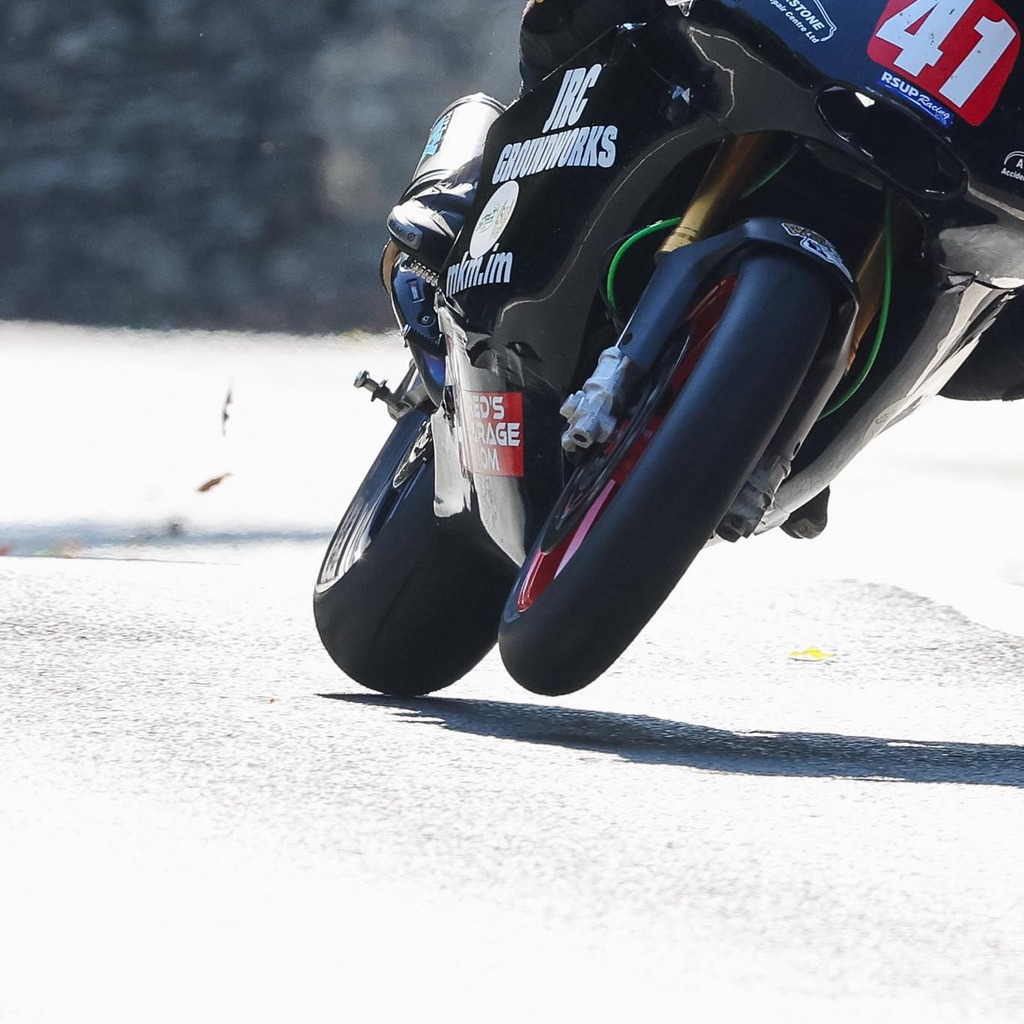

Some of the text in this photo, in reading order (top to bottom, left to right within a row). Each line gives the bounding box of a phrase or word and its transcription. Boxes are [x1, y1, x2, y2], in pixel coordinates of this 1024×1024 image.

[785, 8, 807, 33] Centre
[805, 28, 819, 44] Ltd
[542, 63, 602, 133] JRC
[880, 71, 950, 119] RSUP Racing
[492, 125, 618, 185] GROUNDWORKS
[447, 243, 513, 297] mkm.im
[472, 396, 505, 420] ED'S
[473, 422, 521, 447] RAGE
